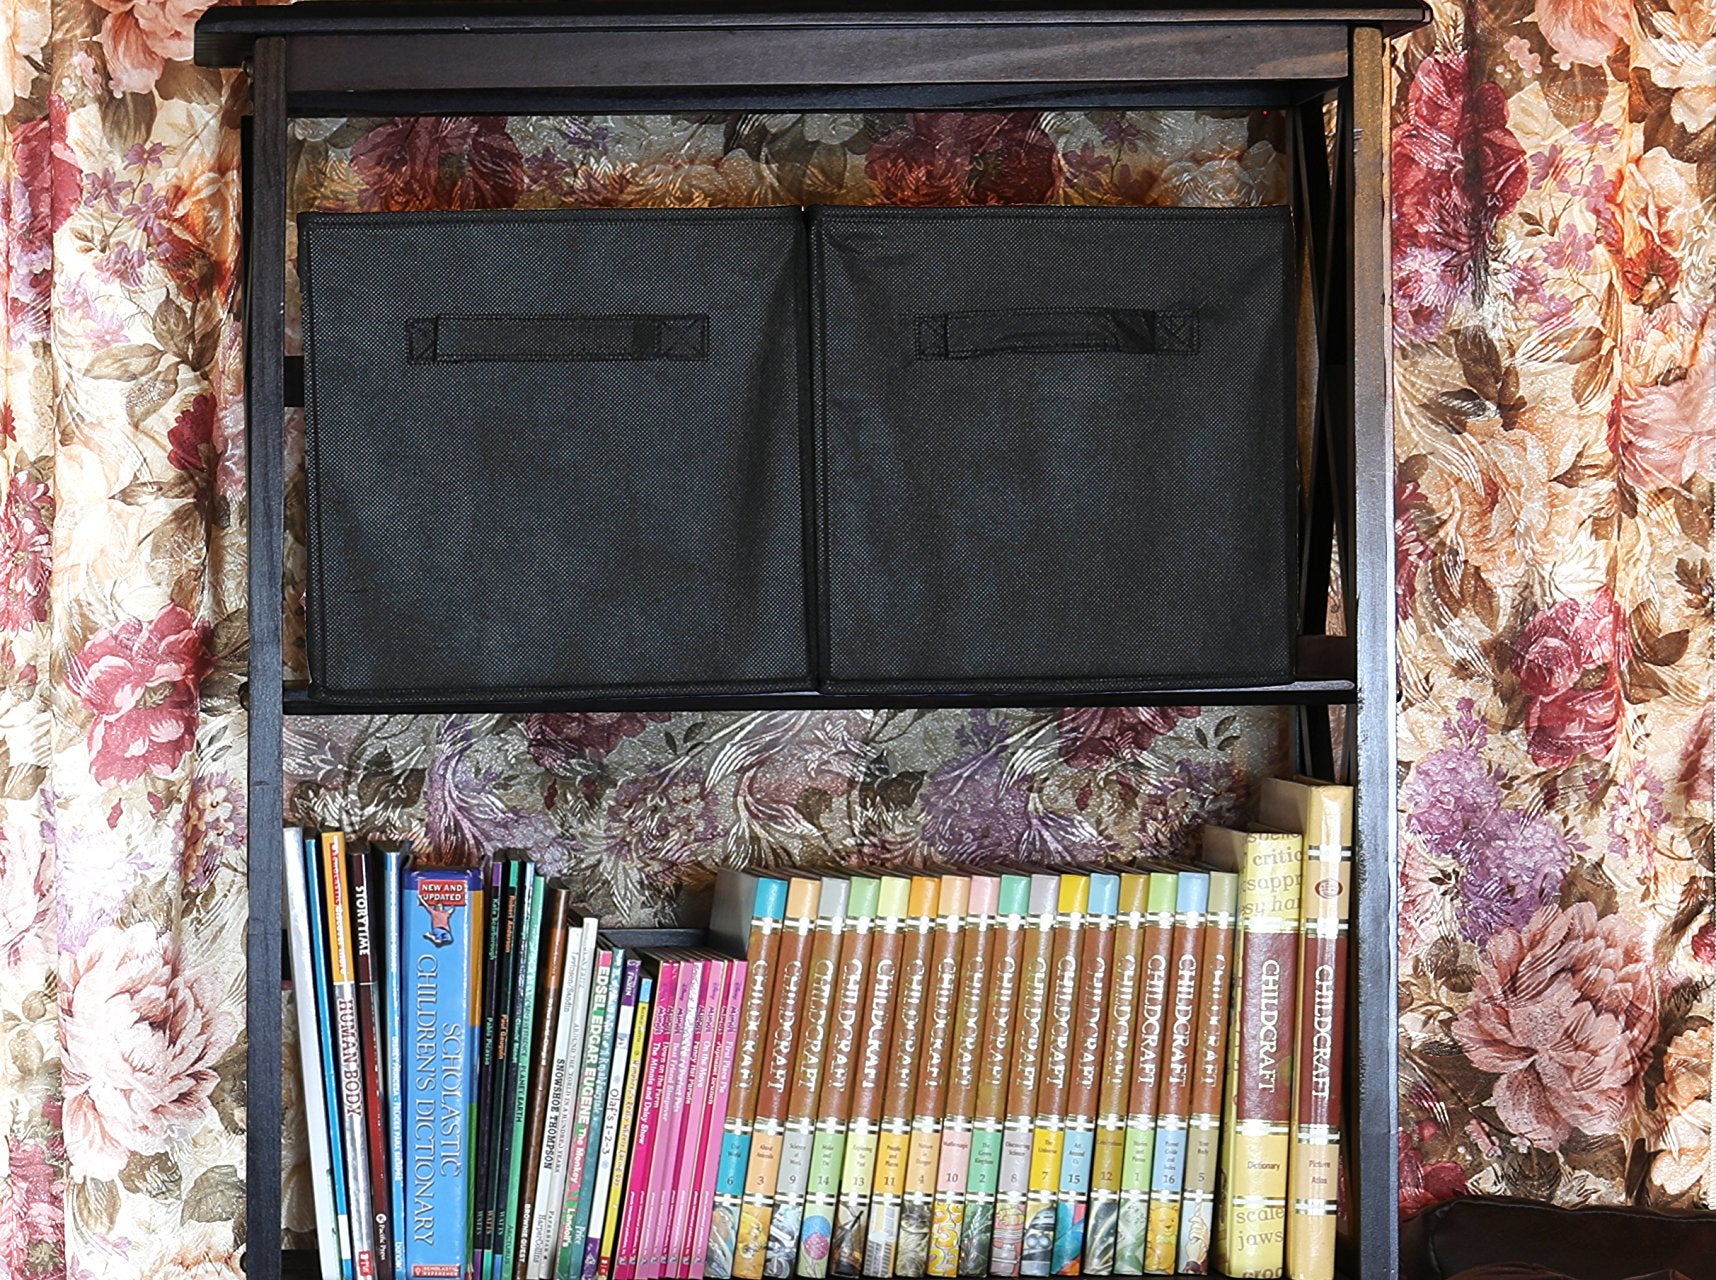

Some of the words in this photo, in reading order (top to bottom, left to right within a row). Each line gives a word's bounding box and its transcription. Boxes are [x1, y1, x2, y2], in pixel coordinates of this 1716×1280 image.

[422, 884, 441, 892] NEW
[444, 884, 463, 892] AND
[423, 893, 461, 901] UPDATED
[491, 898, 499, 915] Kate
[507, 895, 515, 919] Robert
[355, 885, 370, 956] STORYTIME
[488, 917, 498, 961] Scarborough
[505, 920, 513, 953] Anderson
[593, 965, 610, 1011] EDSEL
[624, 971, 635, 997] FROZEN
[337, 998, 358, 1064] HUMAN
[415, 954, 438, 1092] CHILDREN'S
[500, 1014, 508, 1030] Paul
[1046, 955, 1076, 1088] CHILDCRAFT
[1137, 954, 1167, 1088] CHILDCRAFT
[1169, 953, 1197, 1088] CHILDCRAFT
[1258, 959, 1280, 1093] CHILDCRAFT
[569, 1023, 580, 1054] AROUND
[587, 1015, 602, 1064] EDGAR
[1311, 964, 1334, 1101] CHILDCRAFT
[484, 1038, 492, 1065] Picasso
[498, 1031, 507, 1060] Gauguin
[652, 1042, 661, 1055] The
[660, 1042, 670, 1062] Down
[690, 1041, 700, 1062] Fancy
[702, 1041, 710, 1051] On
[722, 1041, 732, 1059] First
[568, 1055, 577, 1069] THE
[659, 1063, 666, 1073] on
[700, 1052, 709, 1065] the
[647, 1058, 658, 1084] Minnie
[657, 1074, 666, 1086] the
[667, 1058, 678, 1083] Friend
[688, 1065, 697, 1077] Hat
[697, 1066, 707, 1088] Move
[720, 1061, 729, 1080] Place
[342, 1069, 362, 1117] BODY
[551, 1058, 566, 1112] SNOWSHOE
[645, 1086, 654, 1099] and
[686, 1078, 695, 1104] Parade
[719, 1081, 727, 1093] Pie
[440, 1023, 464, 1178] SCHOLASTIC
[578, 1067, 597, 1125] EUGENE
[606, 1088, 621, 1122] Olaf's
[654, 1088, 663, 1109] Farm
[662, 1085, 674, 1122] Sleepover
[515, 1096, 524, 1123] EARTH
[641, 1101, 652, 1123] Daisy
[393, 1131, 402, 1150] PARA
[543, 1115, 559, 1170] THOMPSON
[576, 1128, 587, 1146] The
[601, 1124, 615, 1155] 1-2-3
[638, 1124, 648, 1145] Show
[394, 1151, 403, 1181] SIEMPRE
[555, 1149, 566, 1173] YEARS
[570, 1147, 584, 1184] Monkey
[1247, 1161, 1280, 1171] Dictionary
[1308, 1160, 1330, 1169] Picture
[413, 1099, 436, 1246] DICTIONARY
[726, 1176, 735, 1186] 6
[757, 1175, 765, 1186] 3
[789, 1174, 797, 1185] 9
[818, 1175, 830, 1186] 14
[853, 1176, 865, 1186] 13
[884, 1176, 895, 1186] 11
[918, 1174, 924, 1184] 4
[946, 1172, 958, 1183] 10
[979, 1173, 986, 1183] 2
[1010, 1173, 1017, 1183] 8
[1041, 1171, 1049, 1180] 7
[1068, 1174, 1080, 1184] 15
[1100, 1171, 1113, 1181] 12
[1163, 1174, 1175, 1184] 16
[1197, 1172, 1205, 1182] 5
[1311, 1176, 1328, 1184] Atlas
[521, 1203, 532, 1238] BROWNIE
[562, 1207, 576, 1248] Landoll's
[376, 1224, 386, 1244] Pacific
[505, 1225, 514, 1264] ARCTURUS
[532, 1214, 547, 1264] HarperCollins
[574, 1225, 586, 1245] Price
[1238, 1230, 1283, 1251] jaws
[378, 1244, 387, 1261] Press
[519, 1239, 529, 1263] QUEST
